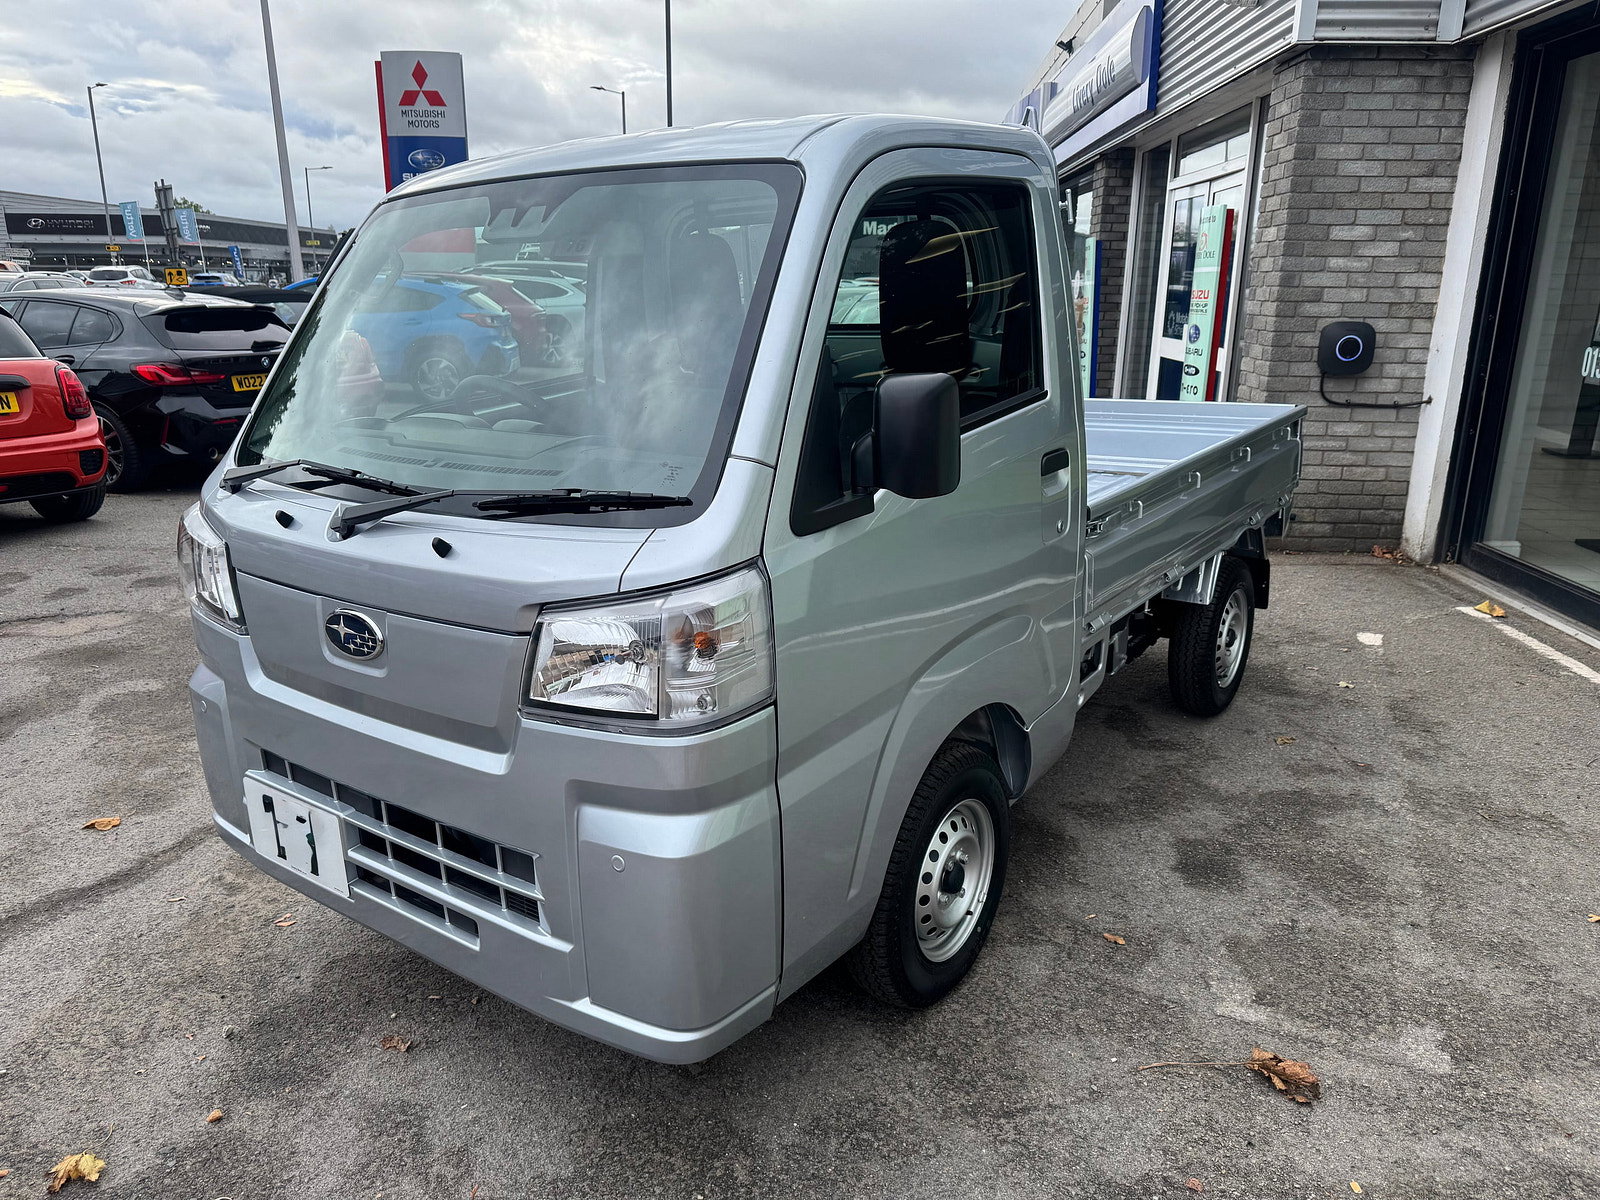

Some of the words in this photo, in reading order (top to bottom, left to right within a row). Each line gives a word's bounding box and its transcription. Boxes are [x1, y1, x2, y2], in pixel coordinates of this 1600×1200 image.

[1073, 85, 1094, 113] Livery
[401, 109, 446, 118] MITSUBISHI
[407, 120, 440, 128] MOTORS
[46, 219, 94, 228] HYUNDAI
